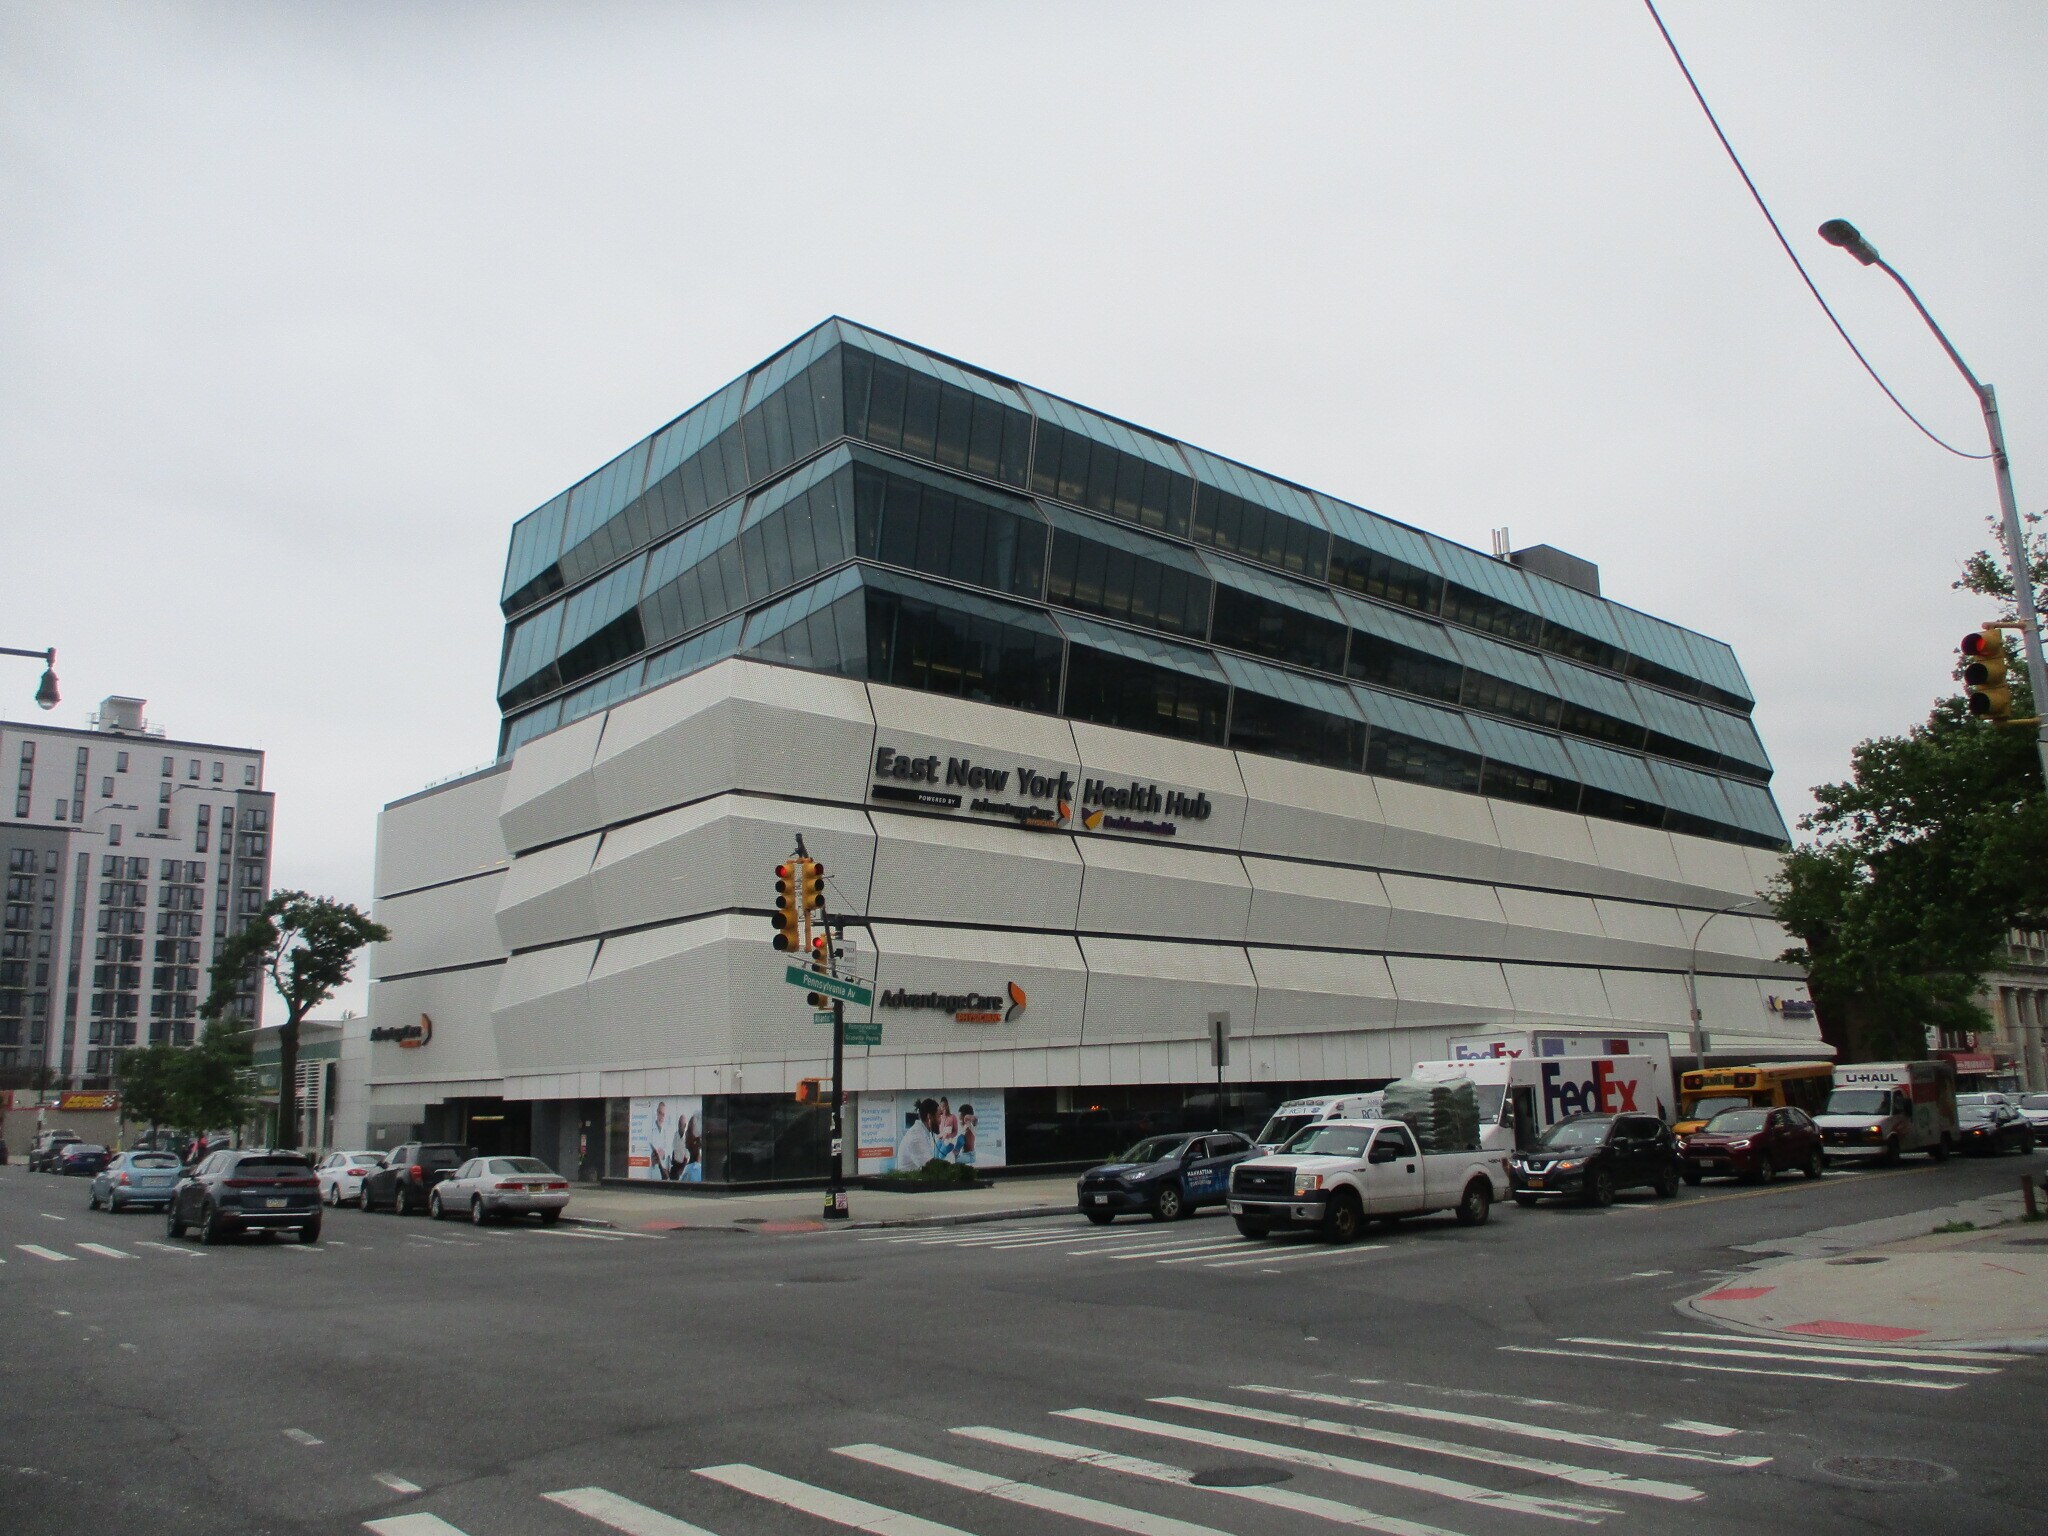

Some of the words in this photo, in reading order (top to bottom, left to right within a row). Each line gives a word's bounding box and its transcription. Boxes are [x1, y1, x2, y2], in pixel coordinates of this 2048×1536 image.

[875, 747, 941, 783] East
[946, 757, 1010, 792] New
[1018, 767, 1075, 801] York
[1083, 778, 1163, 812] Health
[1165, 791, 1212, 820] Hub
[918, 795, 947, 804] POWERED
[948, 797, 956, 805] BY
[802, 974, 846, 996] Pennsylvania
[847, 987, 856, 998] Av
[879, 987, 1004, 1014] AdvantageCare
[955, 1013, 1002, 1023] PHYSICIANS
[1845, 1073, 1899, 1083] U-HAUL
[1541, 1060, 1638, 1125] FedEx
[1186, 1168, 1213, 1177] MANHATTAN
